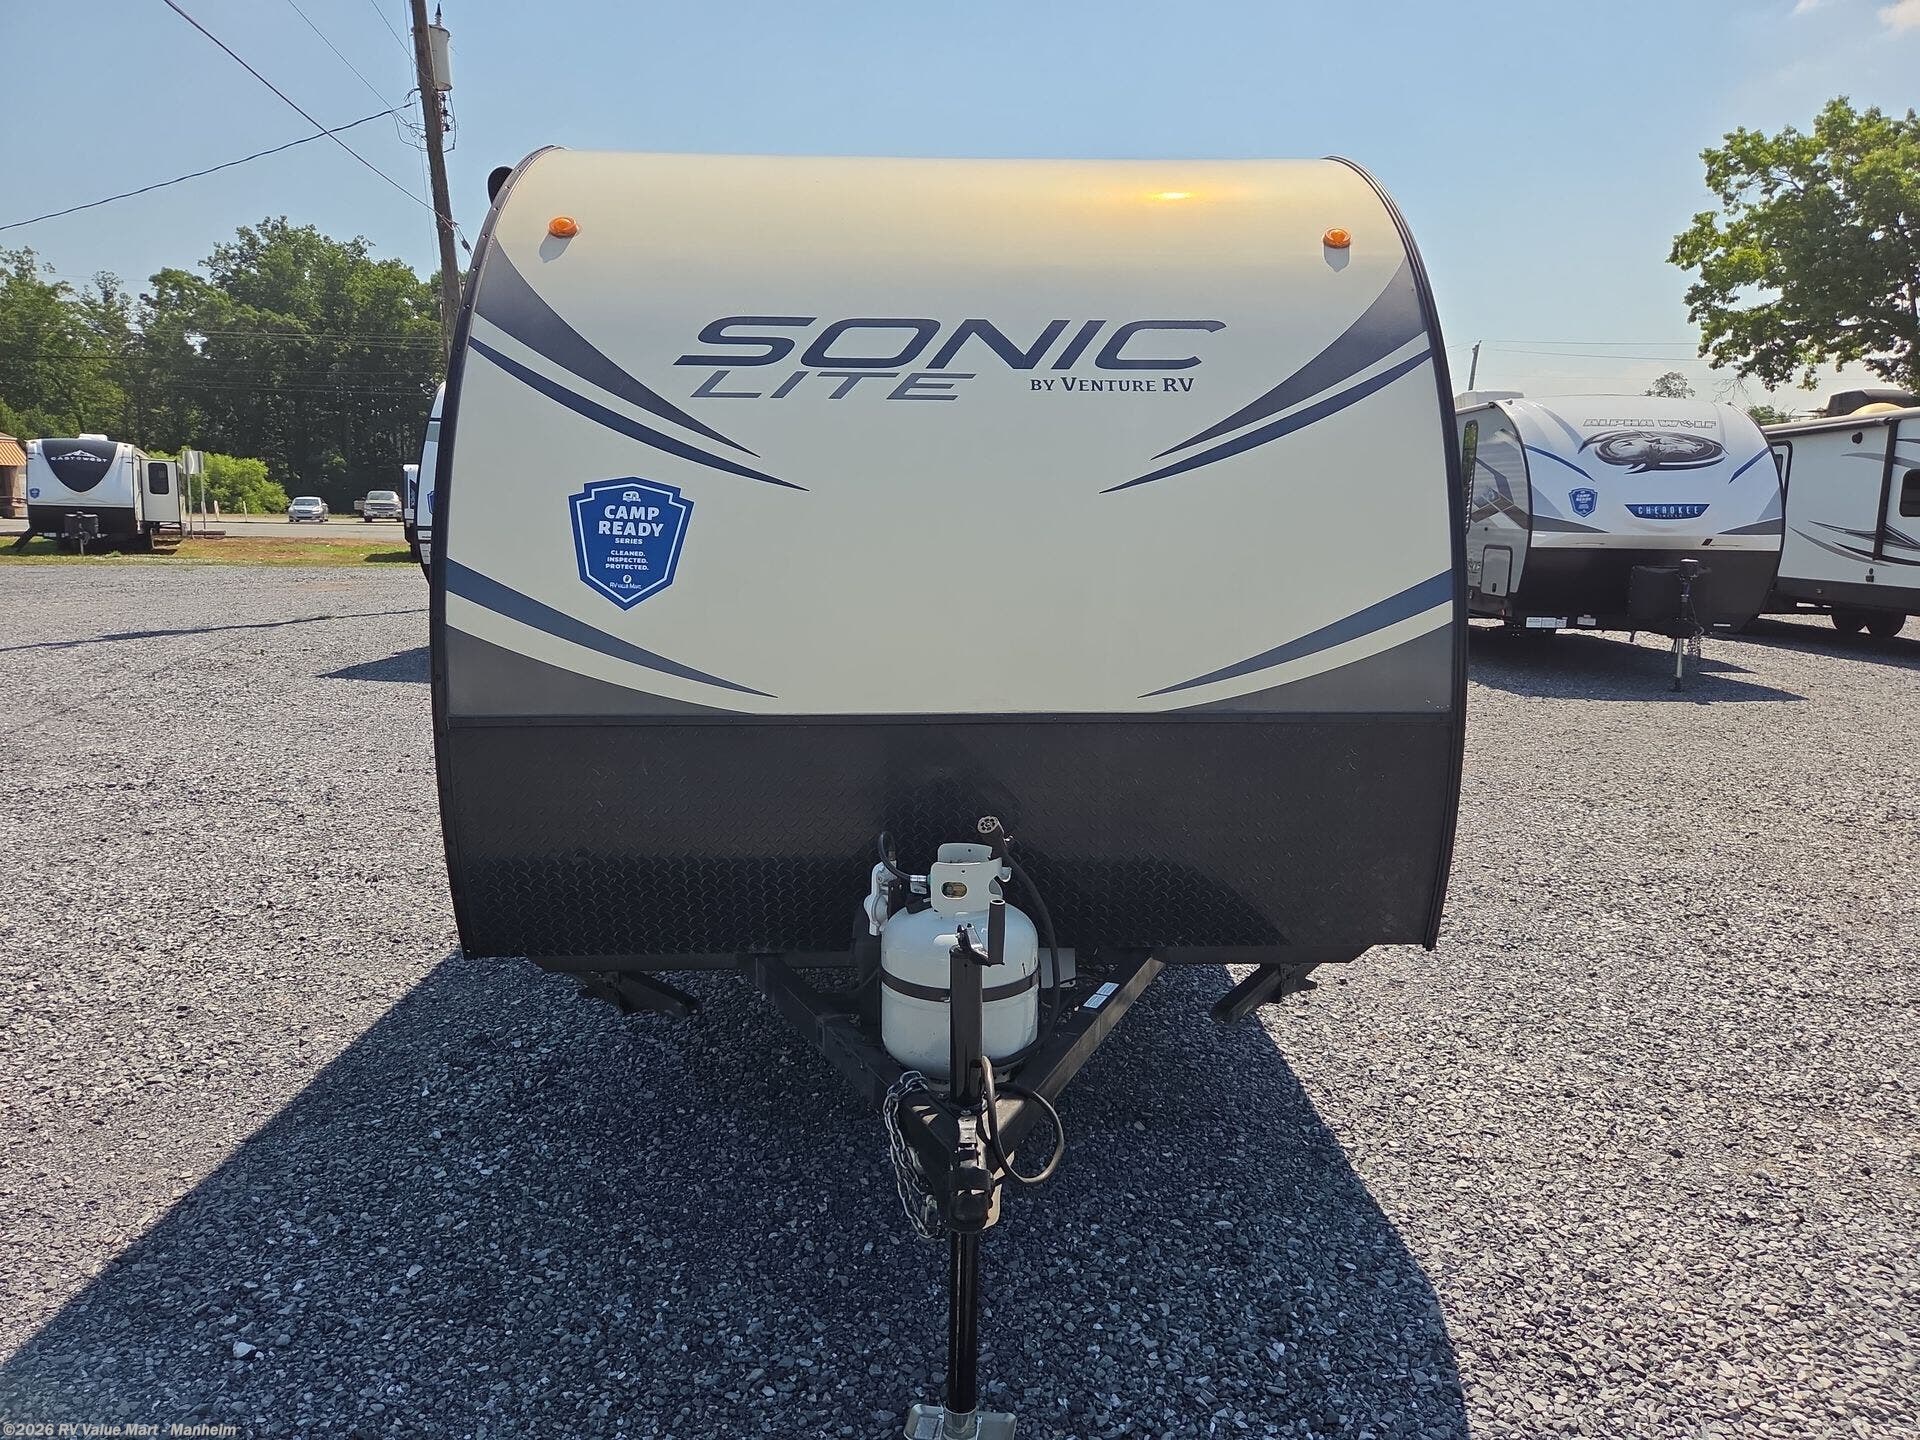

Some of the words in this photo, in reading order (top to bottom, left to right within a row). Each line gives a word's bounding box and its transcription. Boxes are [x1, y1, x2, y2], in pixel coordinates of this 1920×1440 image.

[672, 315, 1227, 371] SONIC
[689, 370, 976, 401] LITE
[1030, 378, 1056, 392] BY
[1060, 376, 1157, 393] VENTURE
[1162, 376, 1195, 393] RV
[1583, 418, 1654, 427] ALPHA
[604, 505, 660, 521] CAMP
[1637, 506, 1699, 515] CHEROKEE
[598, 520, 664, 537] READY
[614, 537, 643, 545] SERIES
[610, 549, 646, 557] CLEANED.
[606, 556, 649, 564] INSPECTED.
[605, 563, 649, 571] PROTECTED.
